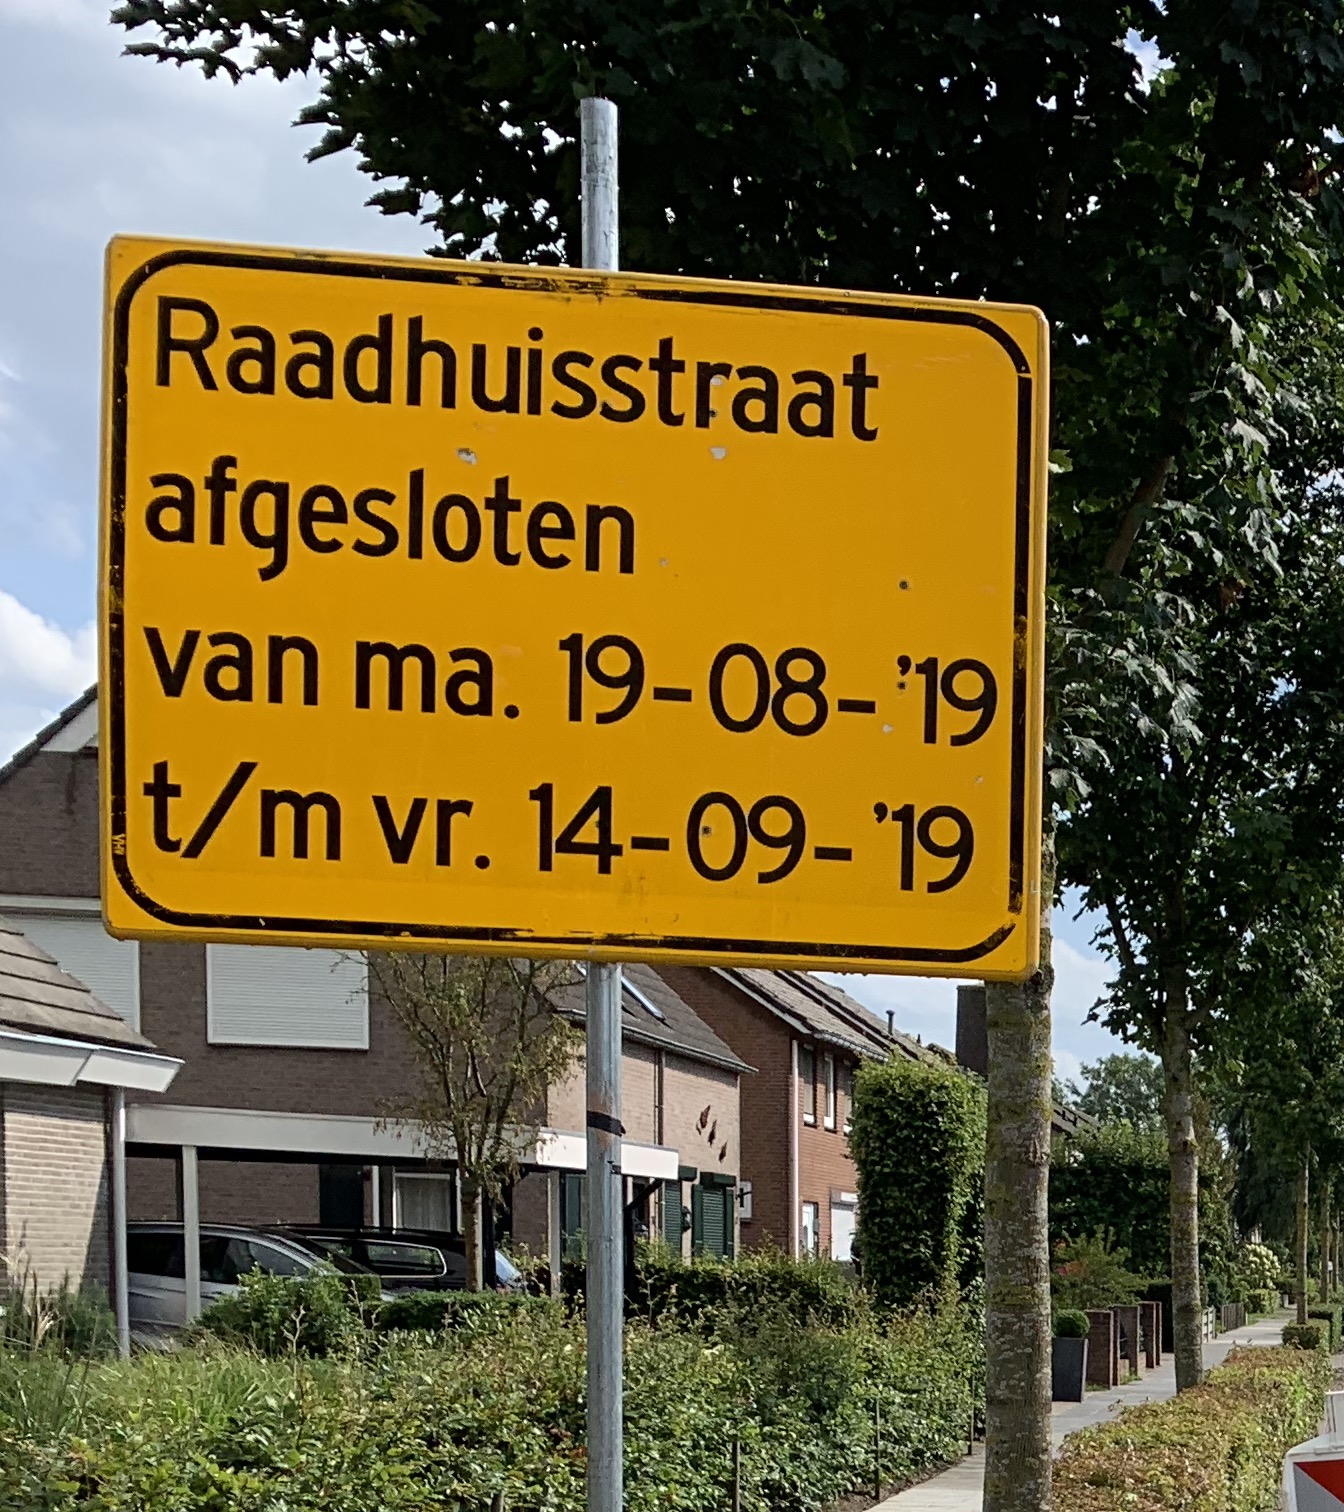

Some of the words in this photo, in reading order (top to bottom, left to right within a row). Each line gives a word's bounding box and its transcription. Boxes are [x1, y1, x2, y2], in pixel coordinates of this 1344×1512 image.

[156, 295, 879, 442] Raadhuisstraat
[145, 455, 635, 582] afgesloten
[143, 627, 319, 706] van
[355, 640, 520, 720] ma.
[143, 760, 341, 861] t/m
[371, 795, 491, 870] vr.
